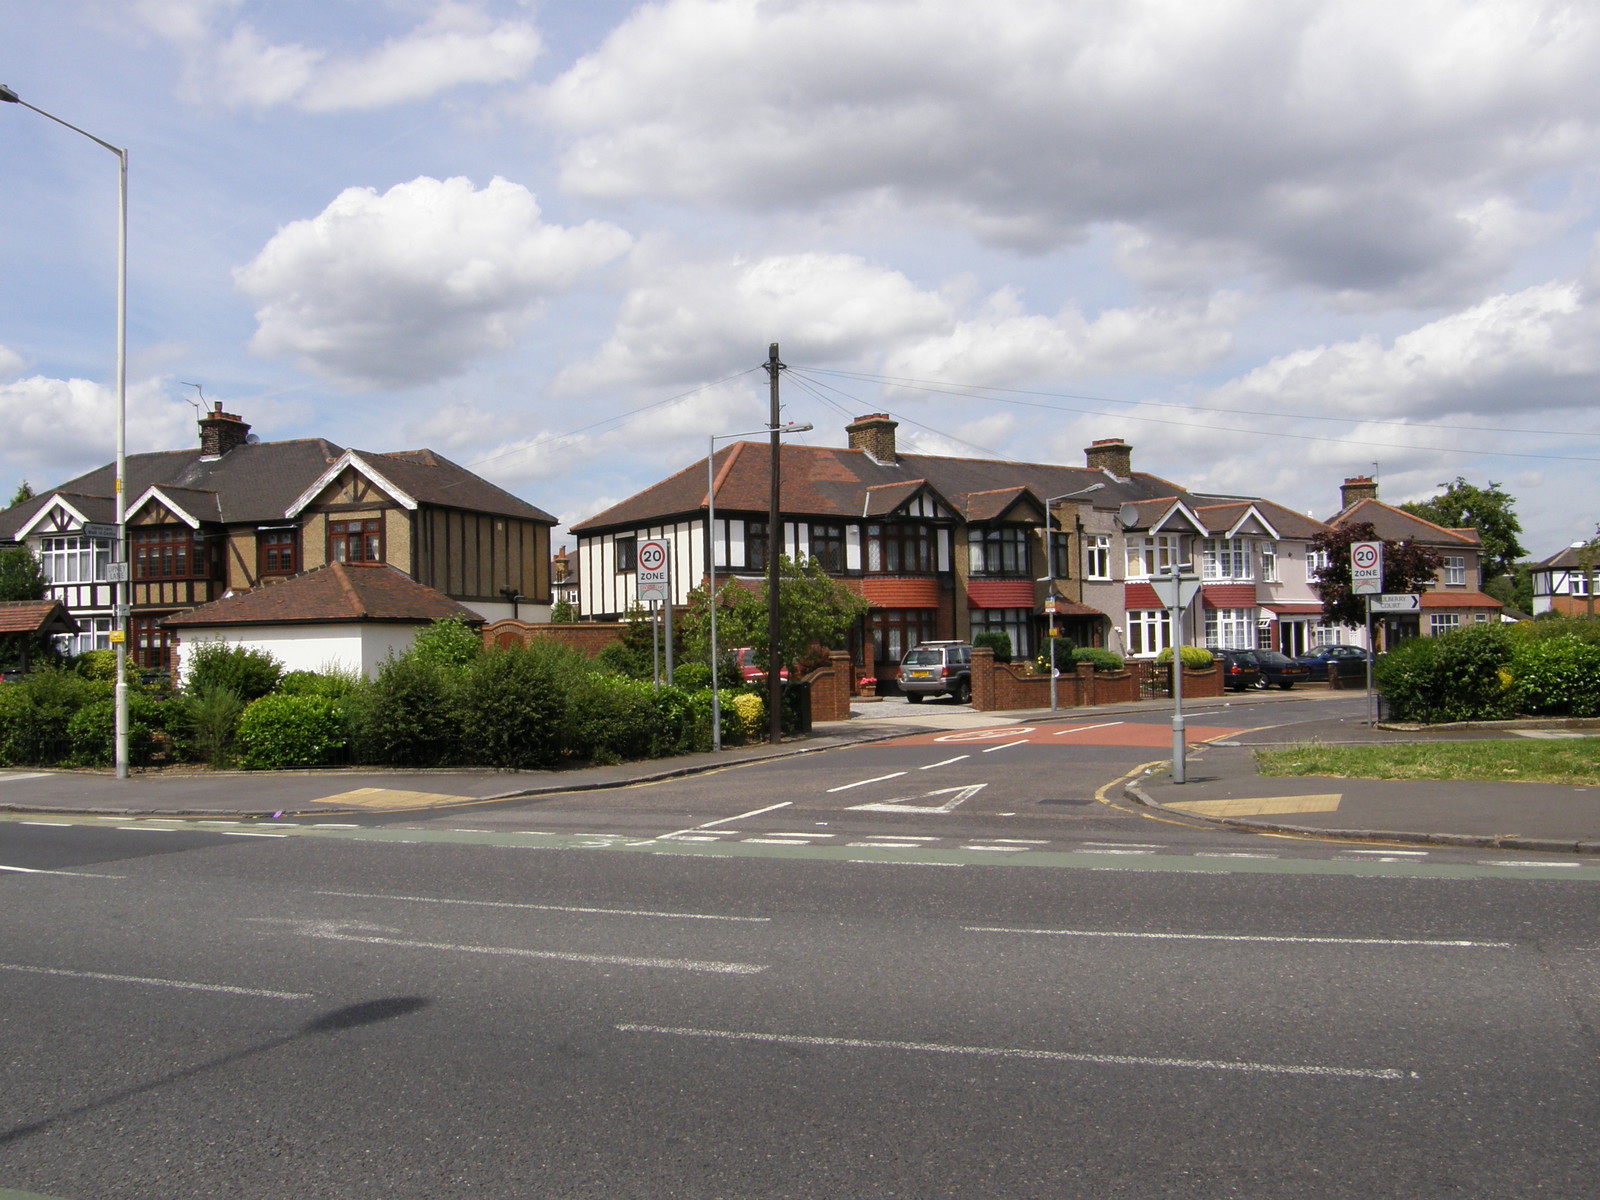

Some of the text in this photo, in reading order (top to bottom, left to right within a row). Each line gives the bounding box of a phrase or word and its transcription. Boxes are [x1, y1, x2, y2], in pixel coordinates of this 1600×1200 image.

[643, 550, 662, 562] 20
[1356, 550, 1374, 562] 20
[640, 572, 665, 581] ZONE
[1354, 569, 1378, 577] ZONE
